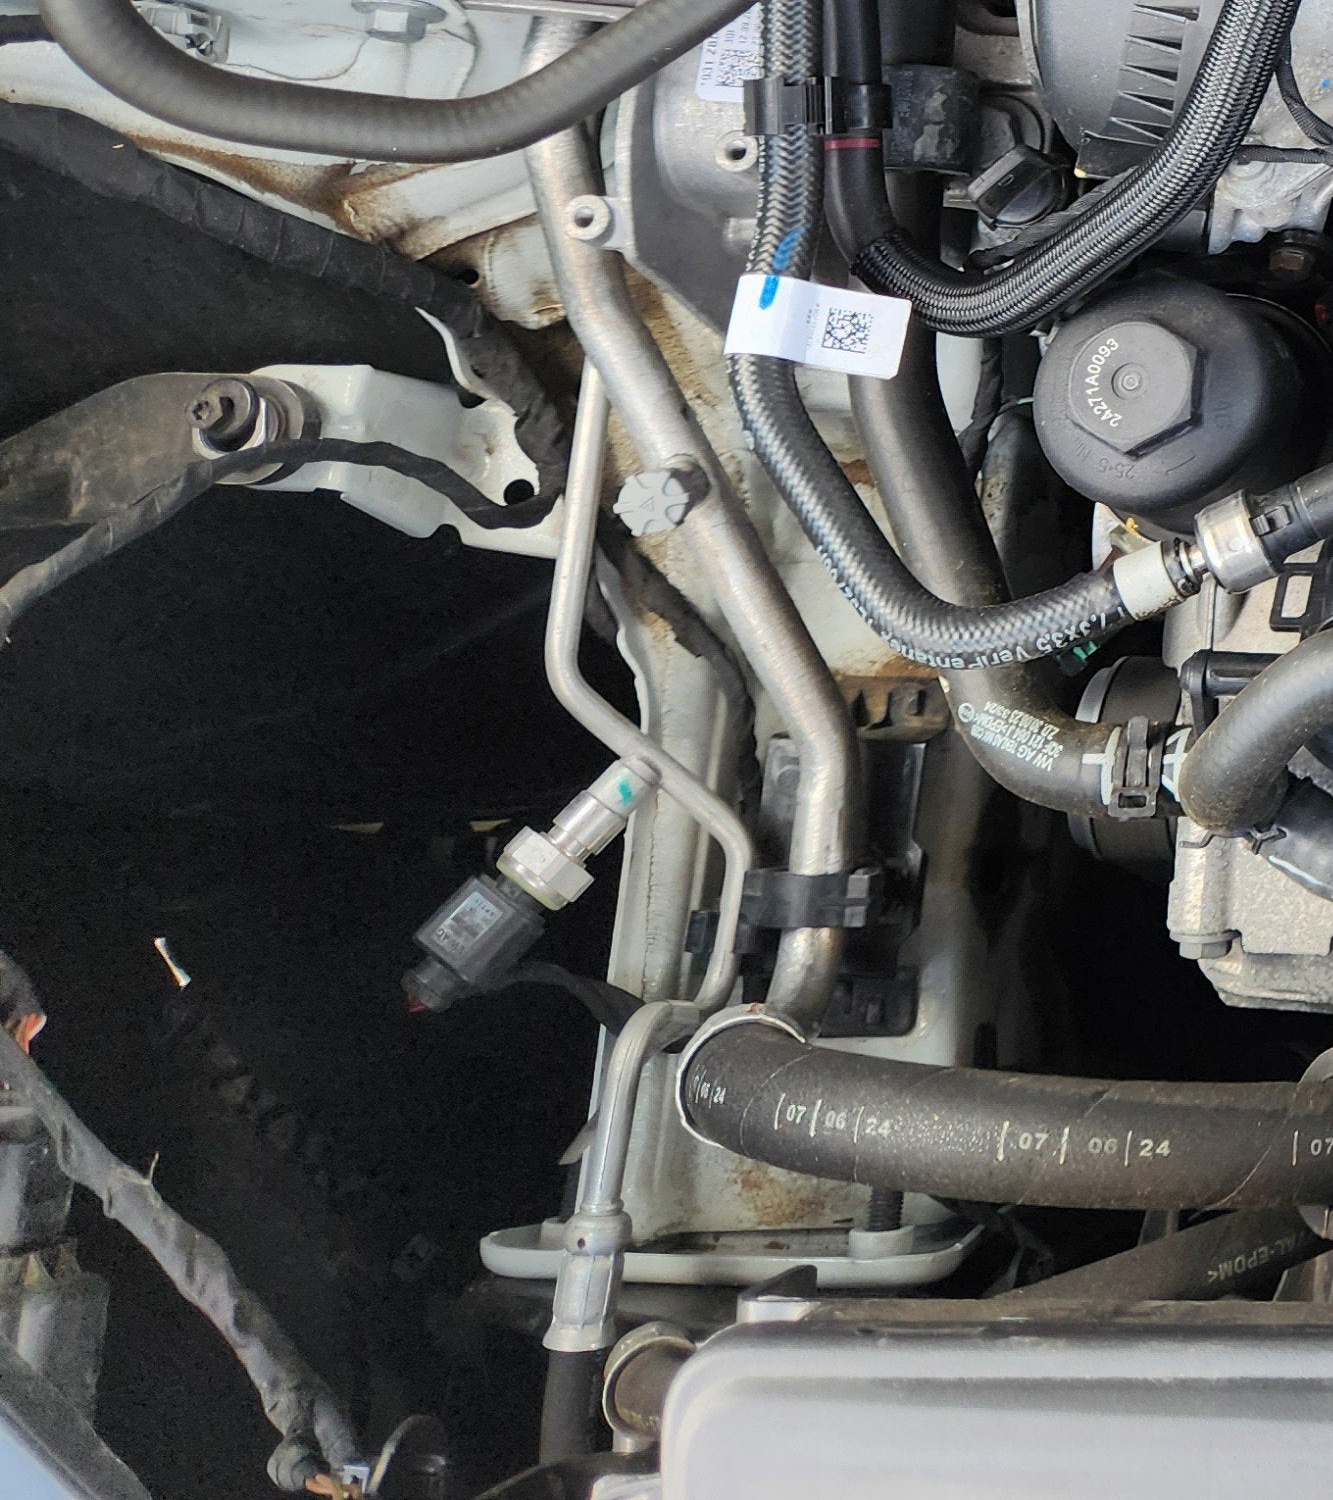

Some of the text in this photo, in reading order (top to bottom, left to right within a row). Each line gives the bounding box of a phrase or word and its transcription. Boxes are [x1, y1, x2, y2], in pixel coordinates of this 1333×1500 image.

[1085, 337, 1122, 427] 24271A0093
[1014, 742, 1036, 763] AG
[1031, 749, 1056, 772] VW
[785, 1104, 807, 1124] 07
[1018, 1131, 1049, 1151] 07
[1139, 1138, 1171, 1158] 24
